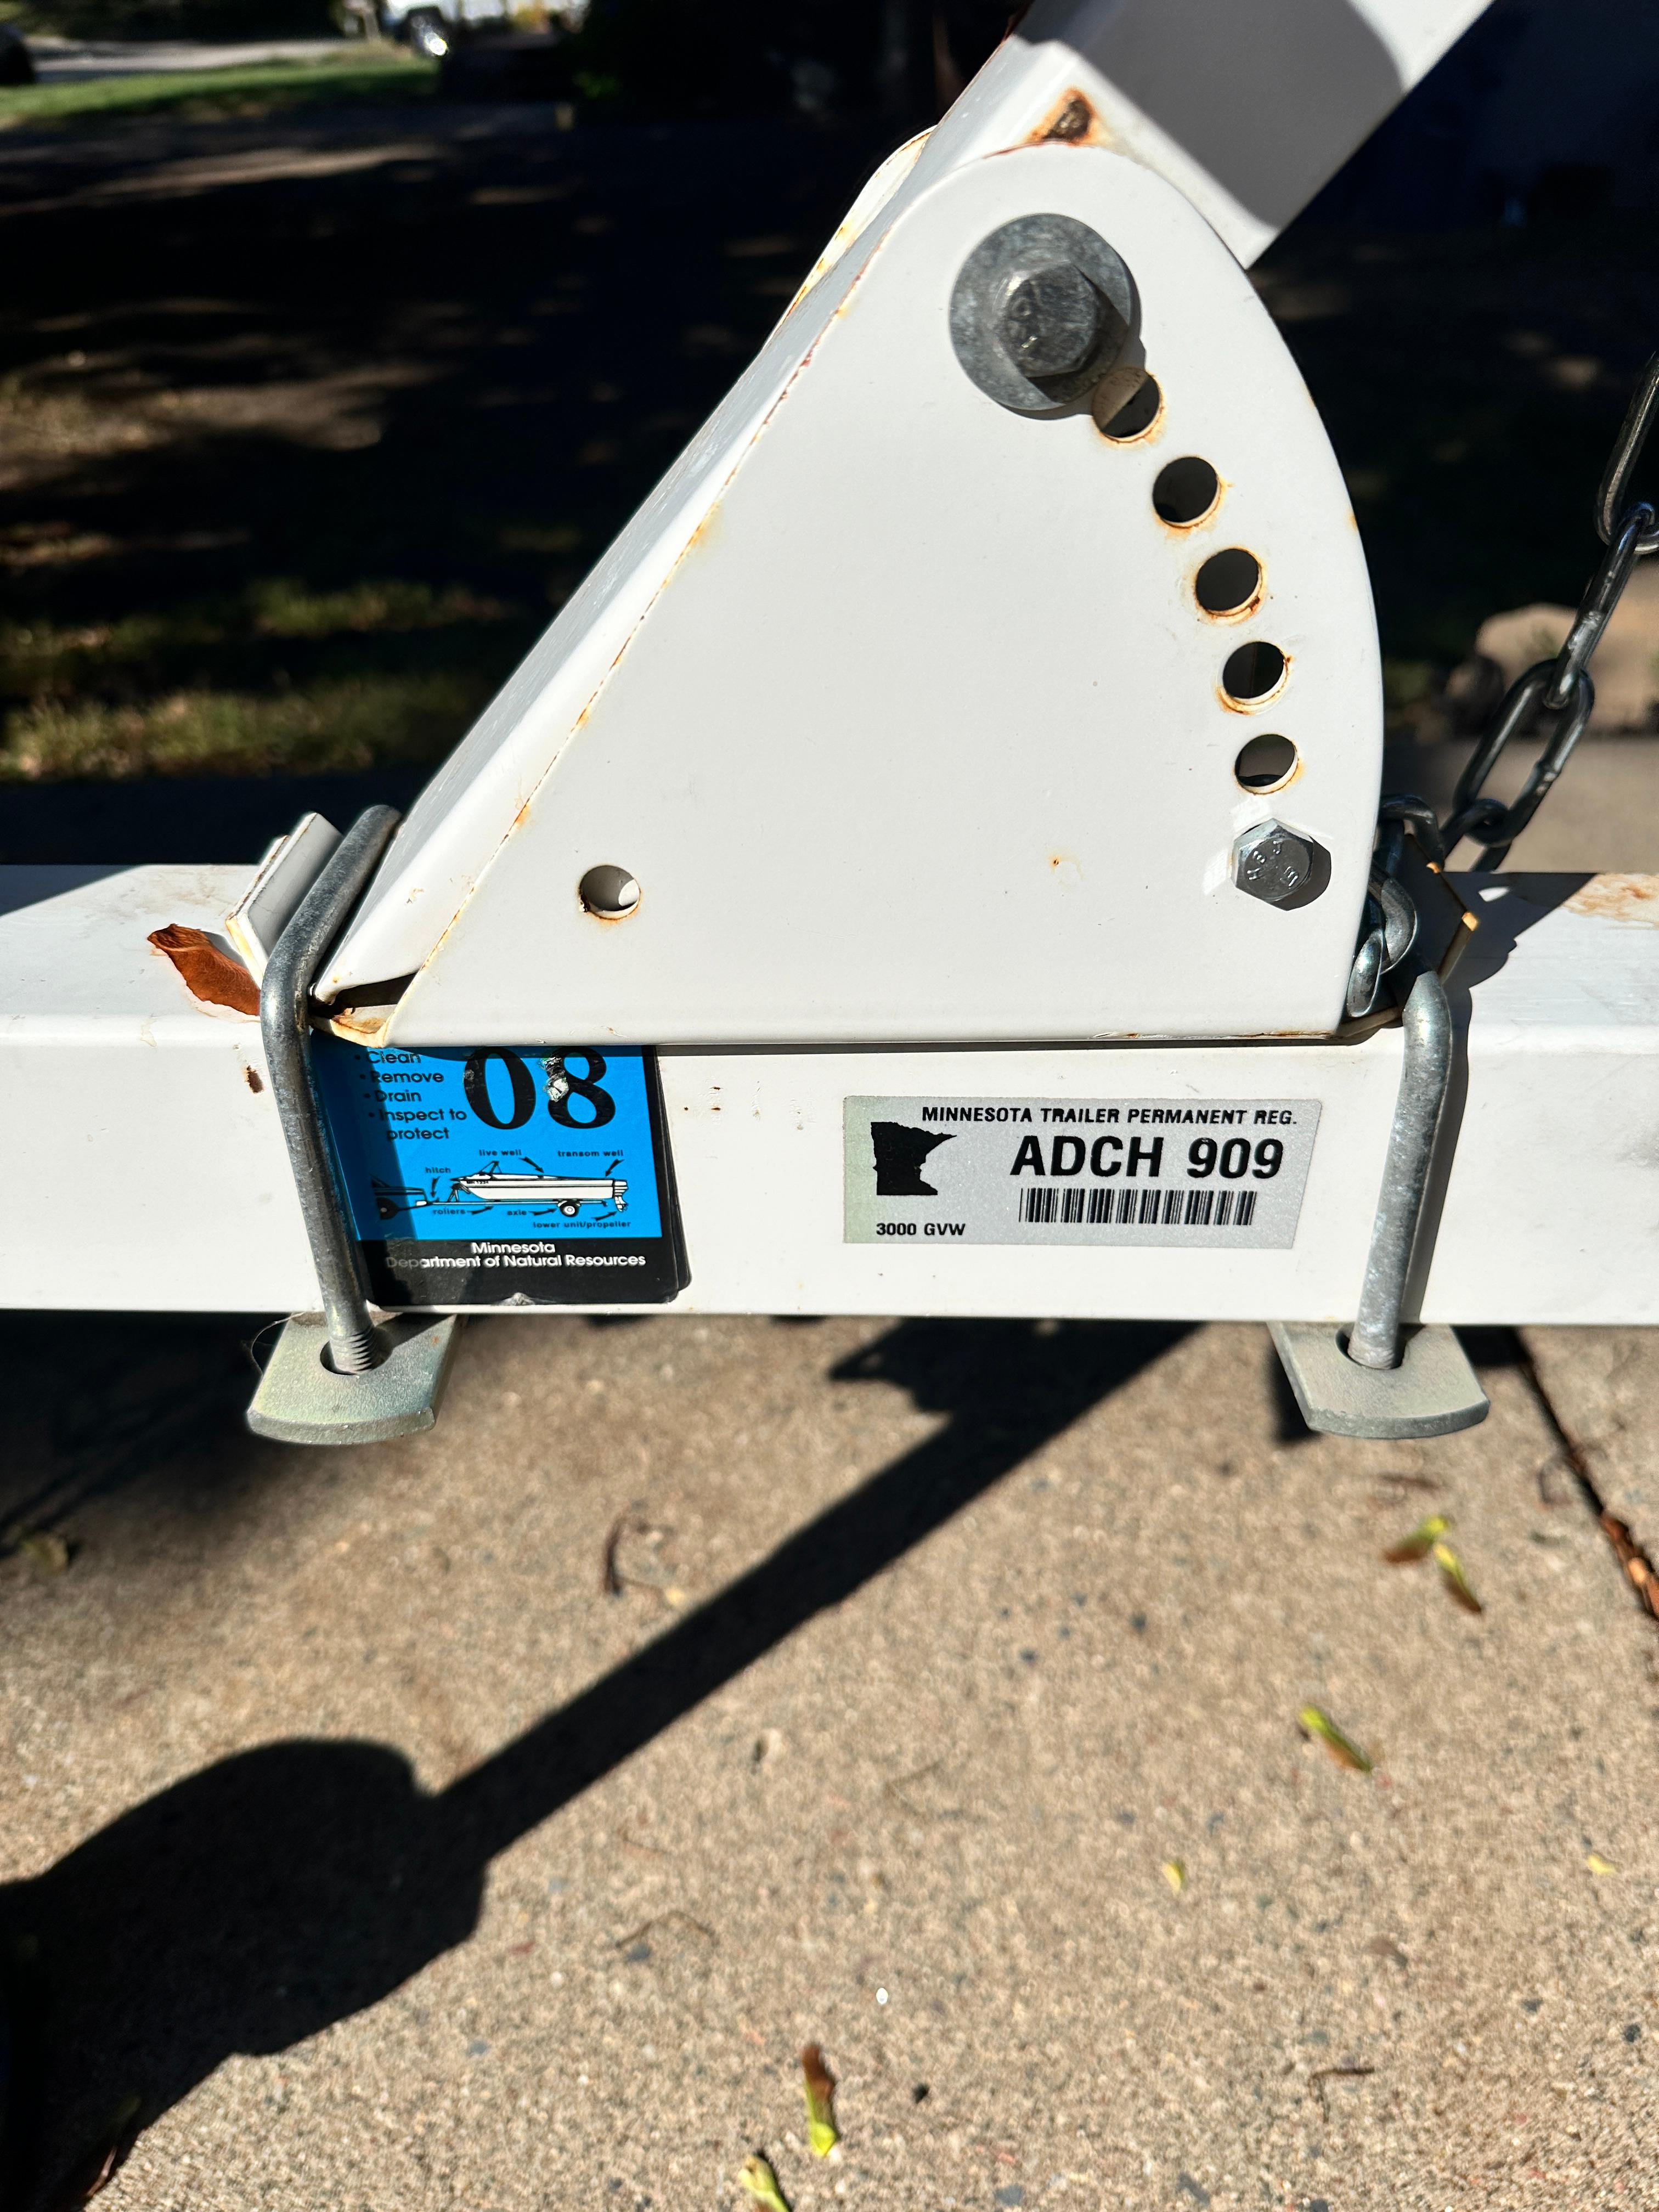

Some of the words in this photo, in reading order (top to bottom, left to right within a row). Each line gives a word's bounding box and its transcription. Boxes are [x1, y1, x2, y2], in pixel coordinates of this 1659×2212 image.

[366, 1051, 421, 1064] Clean
[371, 1070, 444, 1083] Remove
[464, 1046, 616, 1130] 08
[375, 1090, 422, 1102] Drain
[379, 1108, 444, 1123] Inspect
[449, 1108, 467, 1120] to
[922, 1107, 1033, 1122] MINNESOTA
[1040, 1108, 1120, 1123] TRAILER
[1127, 1108, 1248, 1124] PERMANENT
[1253, 1110, 1297, 1125] REG.
[386, 1127, 450, 1141] protect
[1009, 1135, 1164, 1177] ADCH
[1186, 1137, 1284, 1179] 909
[563, 1221, 631, 1229] unit/propeller
[876, 1223, 917, 1236] 3000
[924, 1223, 966, 1236] GVW
[470, 1242, 556, 1254] Minnesota
[386, 1255, 481, 1268] Department
[482, 1255, 500, 1268] of
[503, 1255, 562, 1267] Natural
[564, 1254, 647, 1267] Resources
